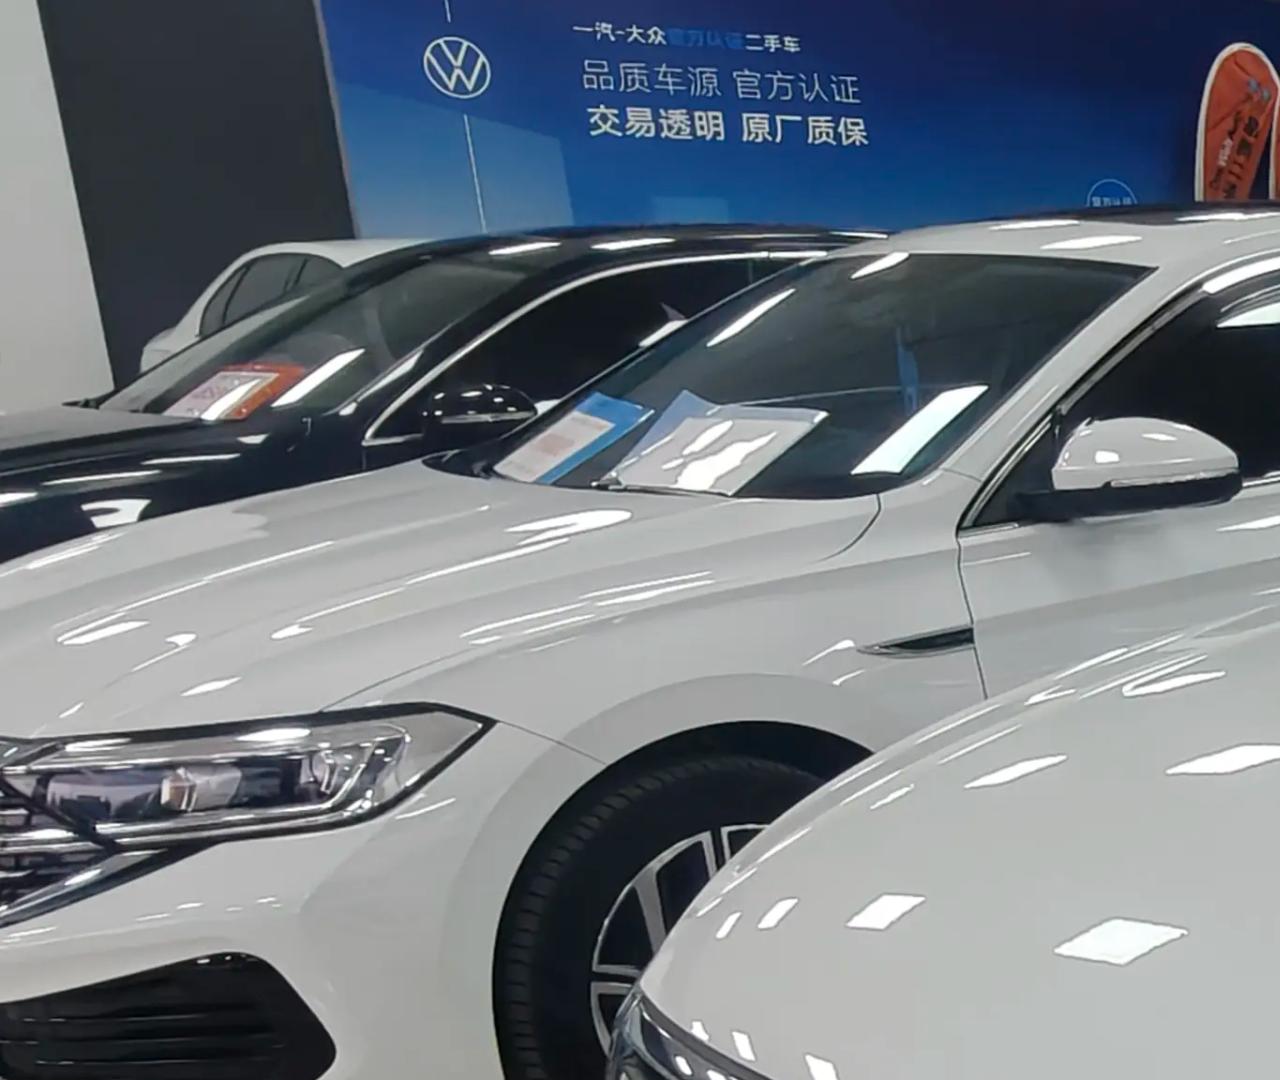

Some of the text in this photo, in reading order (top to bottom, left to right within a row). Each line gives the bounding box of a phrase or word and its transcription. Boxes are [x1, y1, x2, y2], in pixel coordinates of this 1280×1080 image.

[581, 59, 860, 104] 品质车源 官方认证
[587, 104, 869, 147] 交易透明 原厂质保
